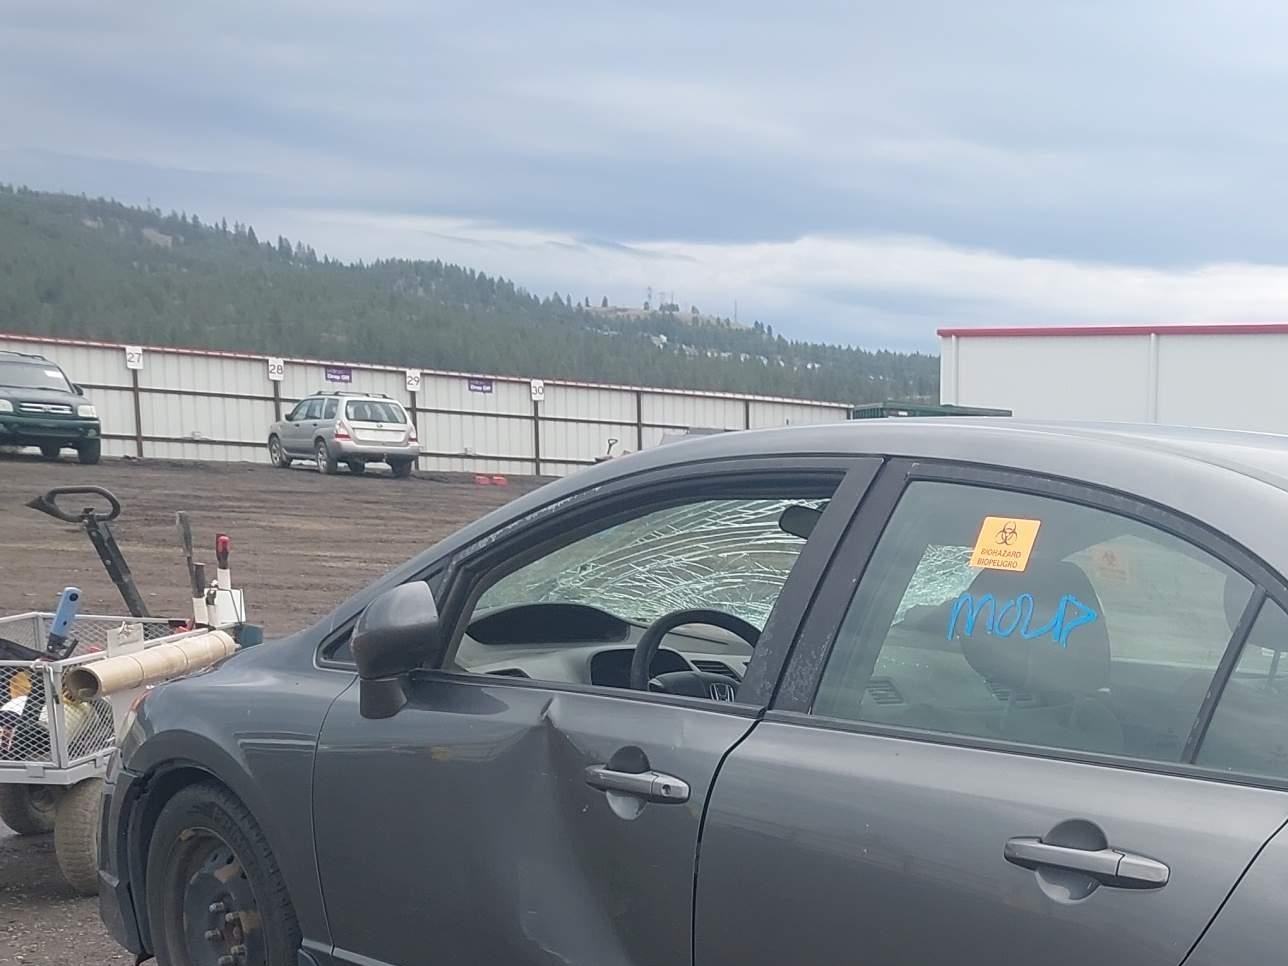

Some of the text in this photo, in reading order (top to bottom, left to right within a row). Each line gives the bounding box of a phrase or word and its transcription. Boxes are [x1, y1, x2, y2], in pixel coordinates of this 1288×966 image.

[127, 352, 141, 363] 27
[269, 364, 284, 375] 28
[407, 375, 420, 386] 29
[531, 384, 544, 395] 30
[980, 548, 1022, 558] BIOHAZARD
[976, 557, 1018, 568] BIOPELIGRO
